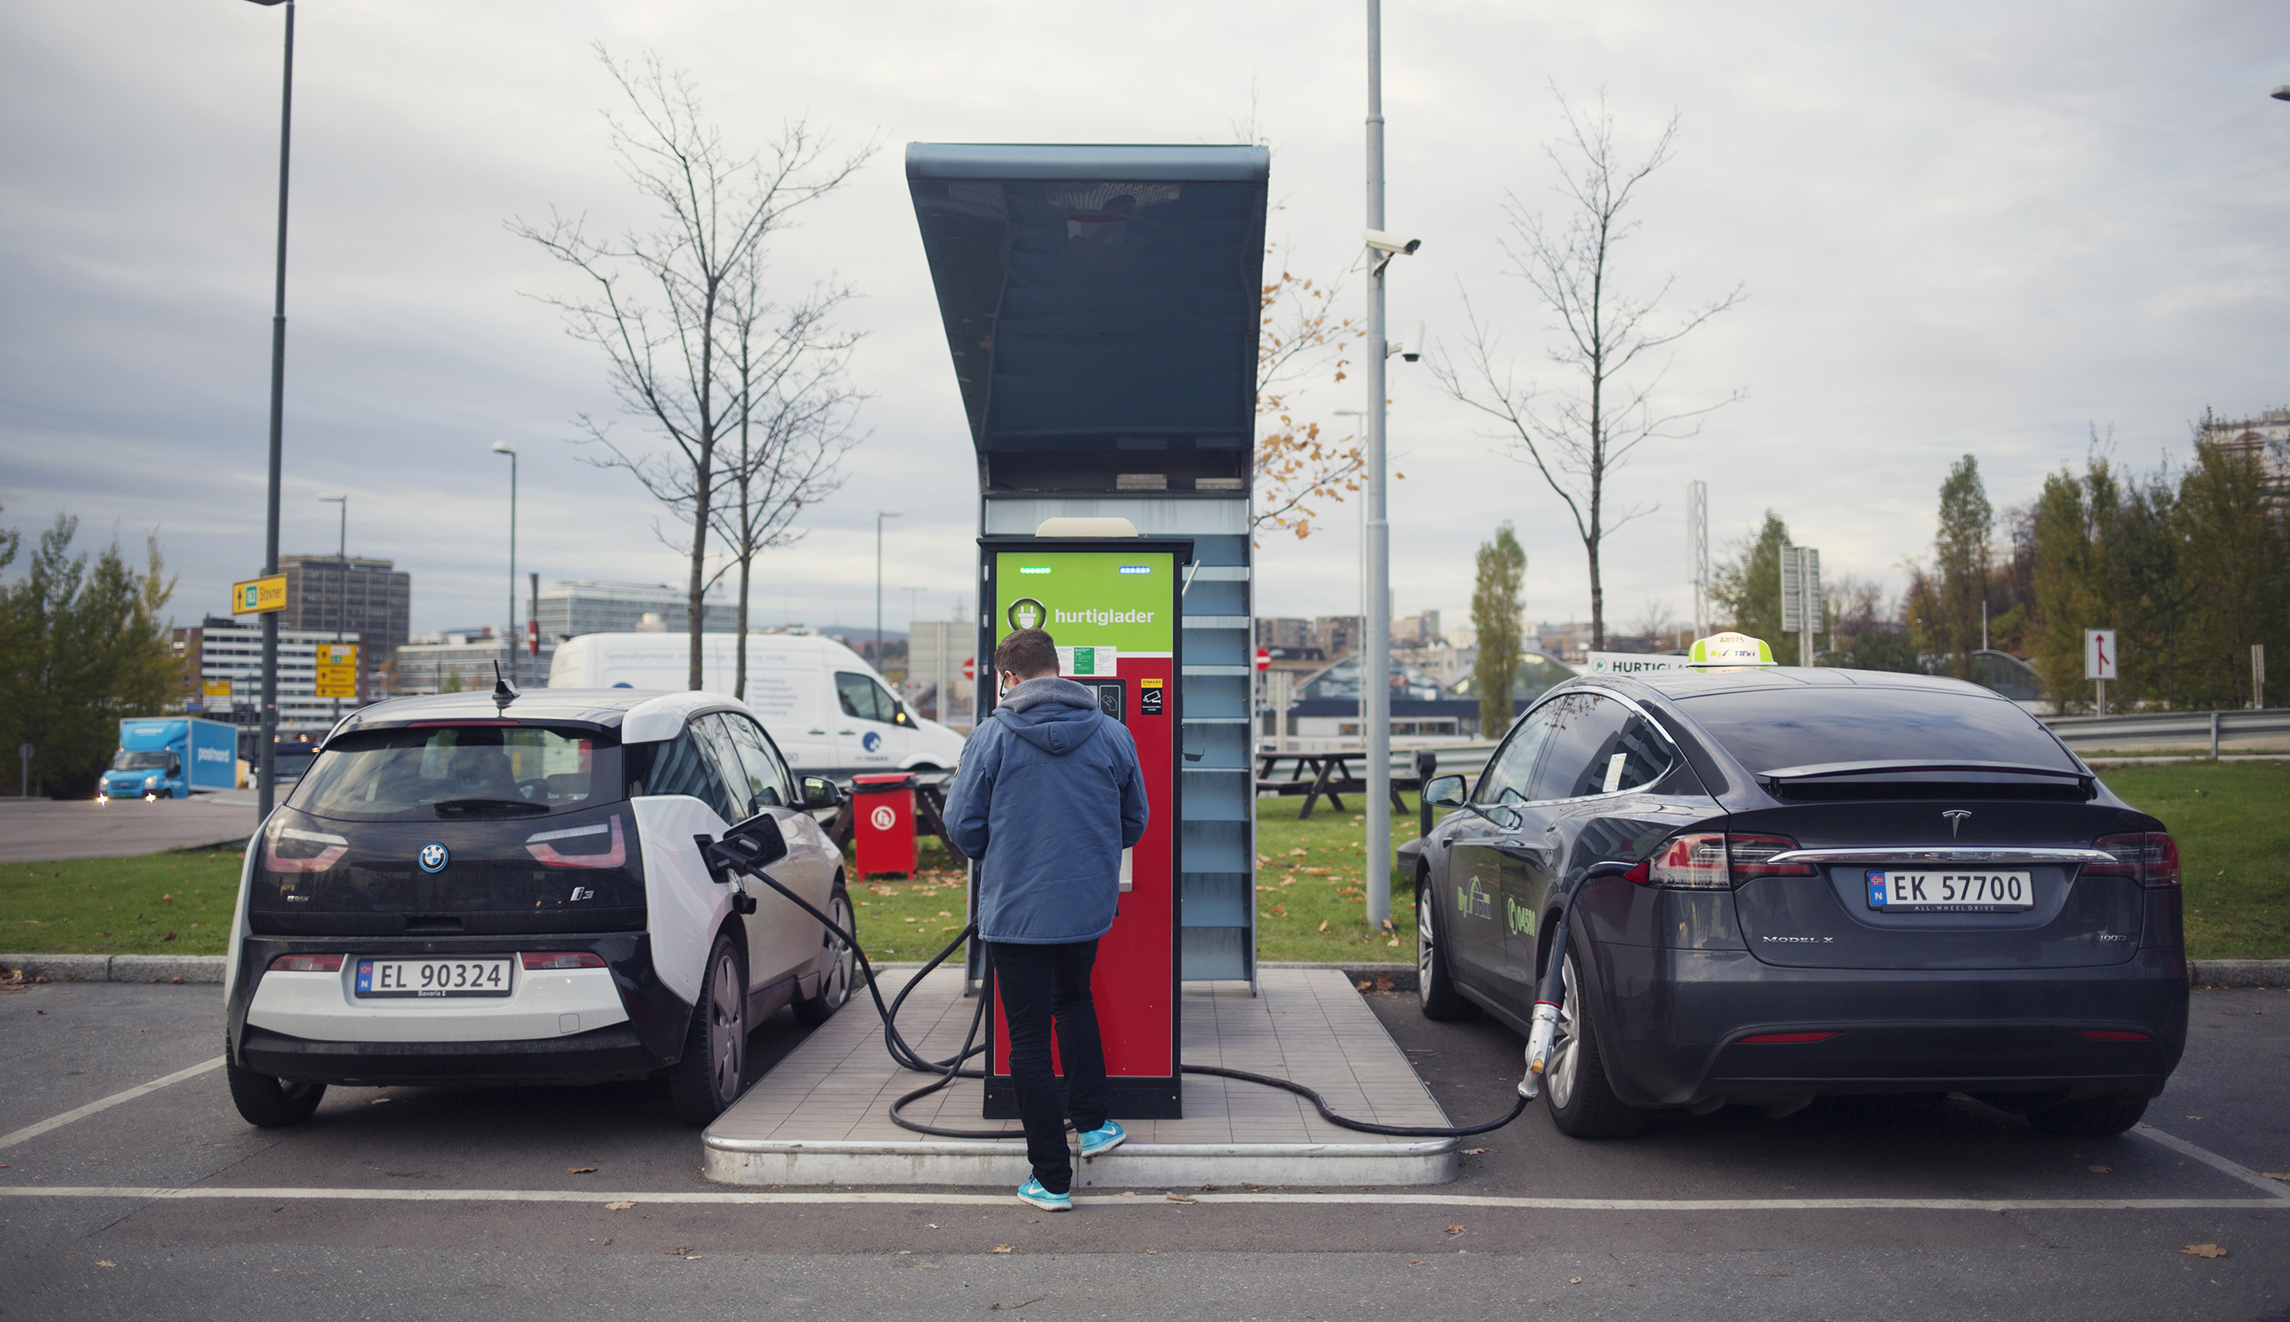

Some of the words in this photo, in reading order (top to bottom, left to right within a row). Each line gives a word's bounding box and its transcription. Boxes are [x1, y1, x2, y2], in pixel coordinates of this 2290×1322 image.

[259, 586, 282, 602] Stovner
[1055, 608, 1154, 626] hurtiglader
[198, 747, 230, 763] postnord
[1874, 892, 1883, 900] N
[1894, 876, 1927, 901] EK
[1942, 876, 2021, 901] 57700
[360, 979, 368, 988] N
[380, 964, 407, 988] EL
[420, 963, 502, 988] 90324
